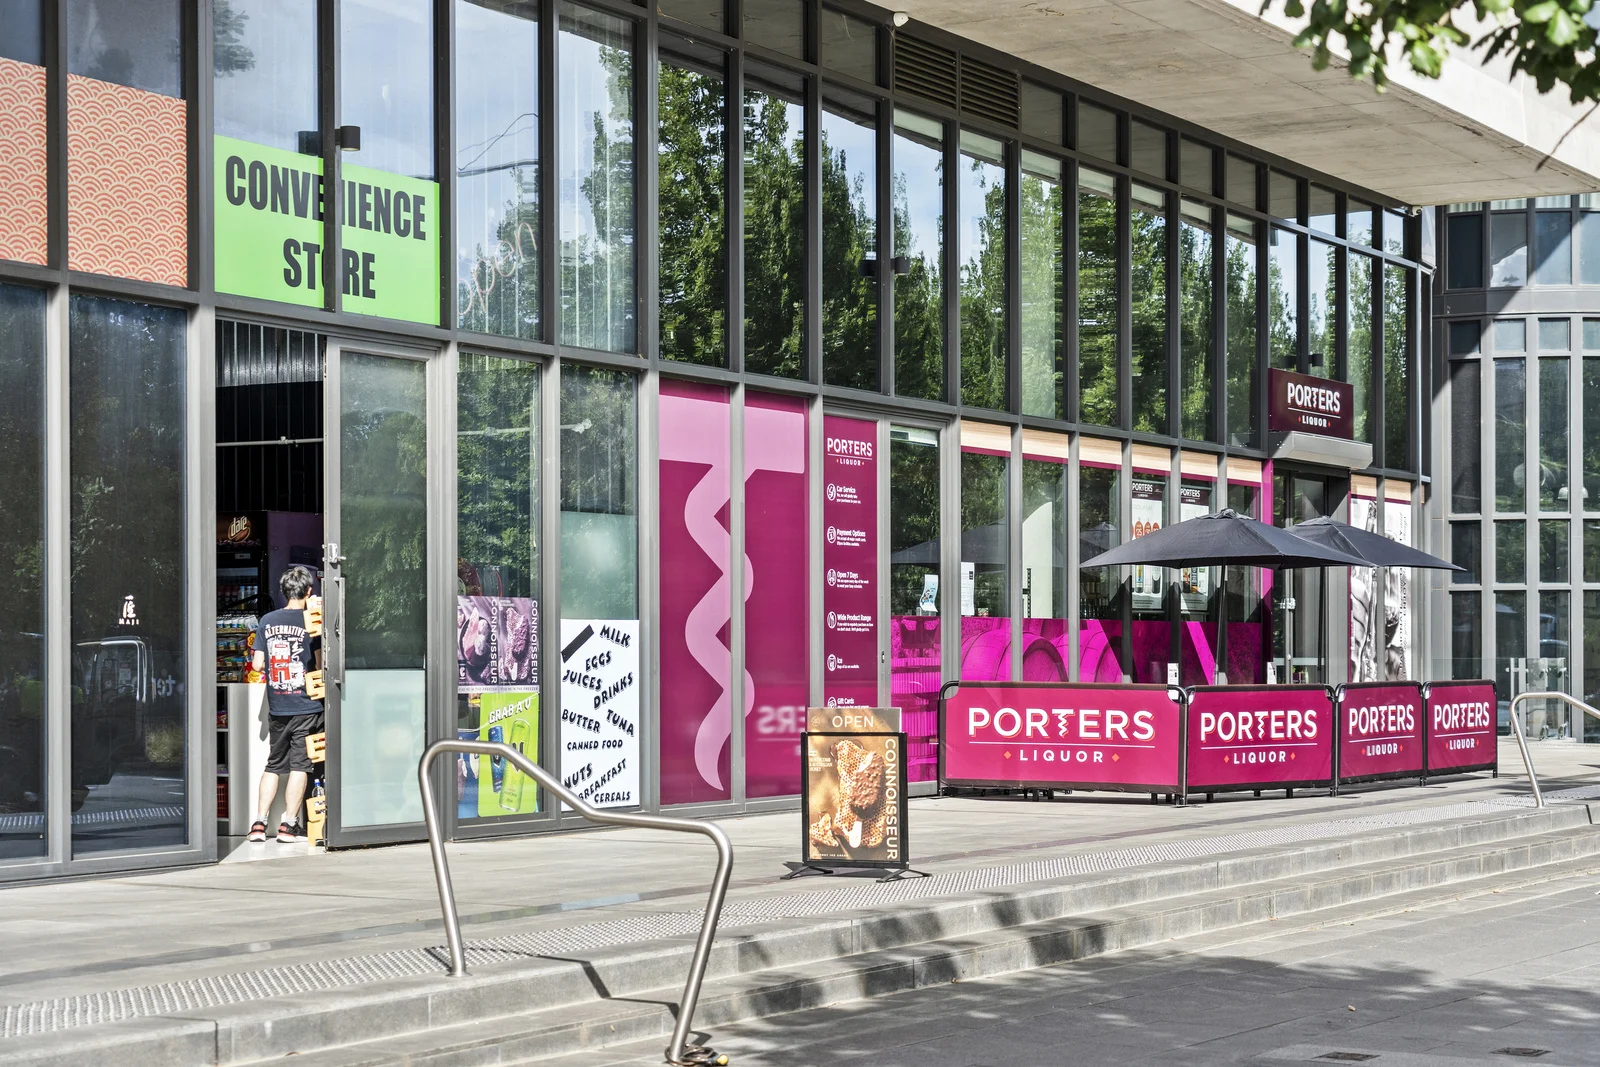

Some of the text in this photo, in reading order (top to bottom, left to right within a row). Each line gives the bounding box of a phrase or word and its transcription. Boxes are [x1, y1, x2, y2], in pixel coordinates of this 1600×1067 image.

[283, 238, 376, 300] STRE
[1287, 382, 1341, 414] PORTERS
[1302, 415, 1328, 428] LIQUOR
[827, 438, 873, 456] PORTERS
[840, 458, 861, 466] LIQUOR
[231, 516, 248, 536] dare
[264, 624, 306, 638] ALTERNATIVE
[490, 599, 498, 684] CONNOISSEUR
[600, 624, 630, 648] MILK
[585, 650, 612, 672] EGGS
[562, 670, 602, 691] JUICES
[594, 672, 633, 710] DRINKS
[489, 704, 514, 724] GRAB
[515, 701, 522, 714] A
[562, 709, 600, 733] BUTTER
[606, 709, 634, 737] TUNA
[832, 716, 874, 728] OPEN
[968, 707, 1155, 741] PORTERS
[1349, 704, 1414, 735] PORTERS
[1434, 702, 1490, 730] PORTERS
[1200, 710, 1317, 742] PORTERS
[567, 739, 623, 751] CANNED FOOD
[1366, 743, 1398, 756] LIQUOR
[1449, 738, 1475, 750] LIQUOR
[1020, 750, 1103, 763] LIQUOR
[1233, 751, 1286, 764] LIQUOR
[564, 763, 593, 790] NUTS
[579, 758, 627, 800] BREAKFAST
[594, 791, 631, 804] CEREALS
[885, 739, 898, 860] CONNOISSEUR
